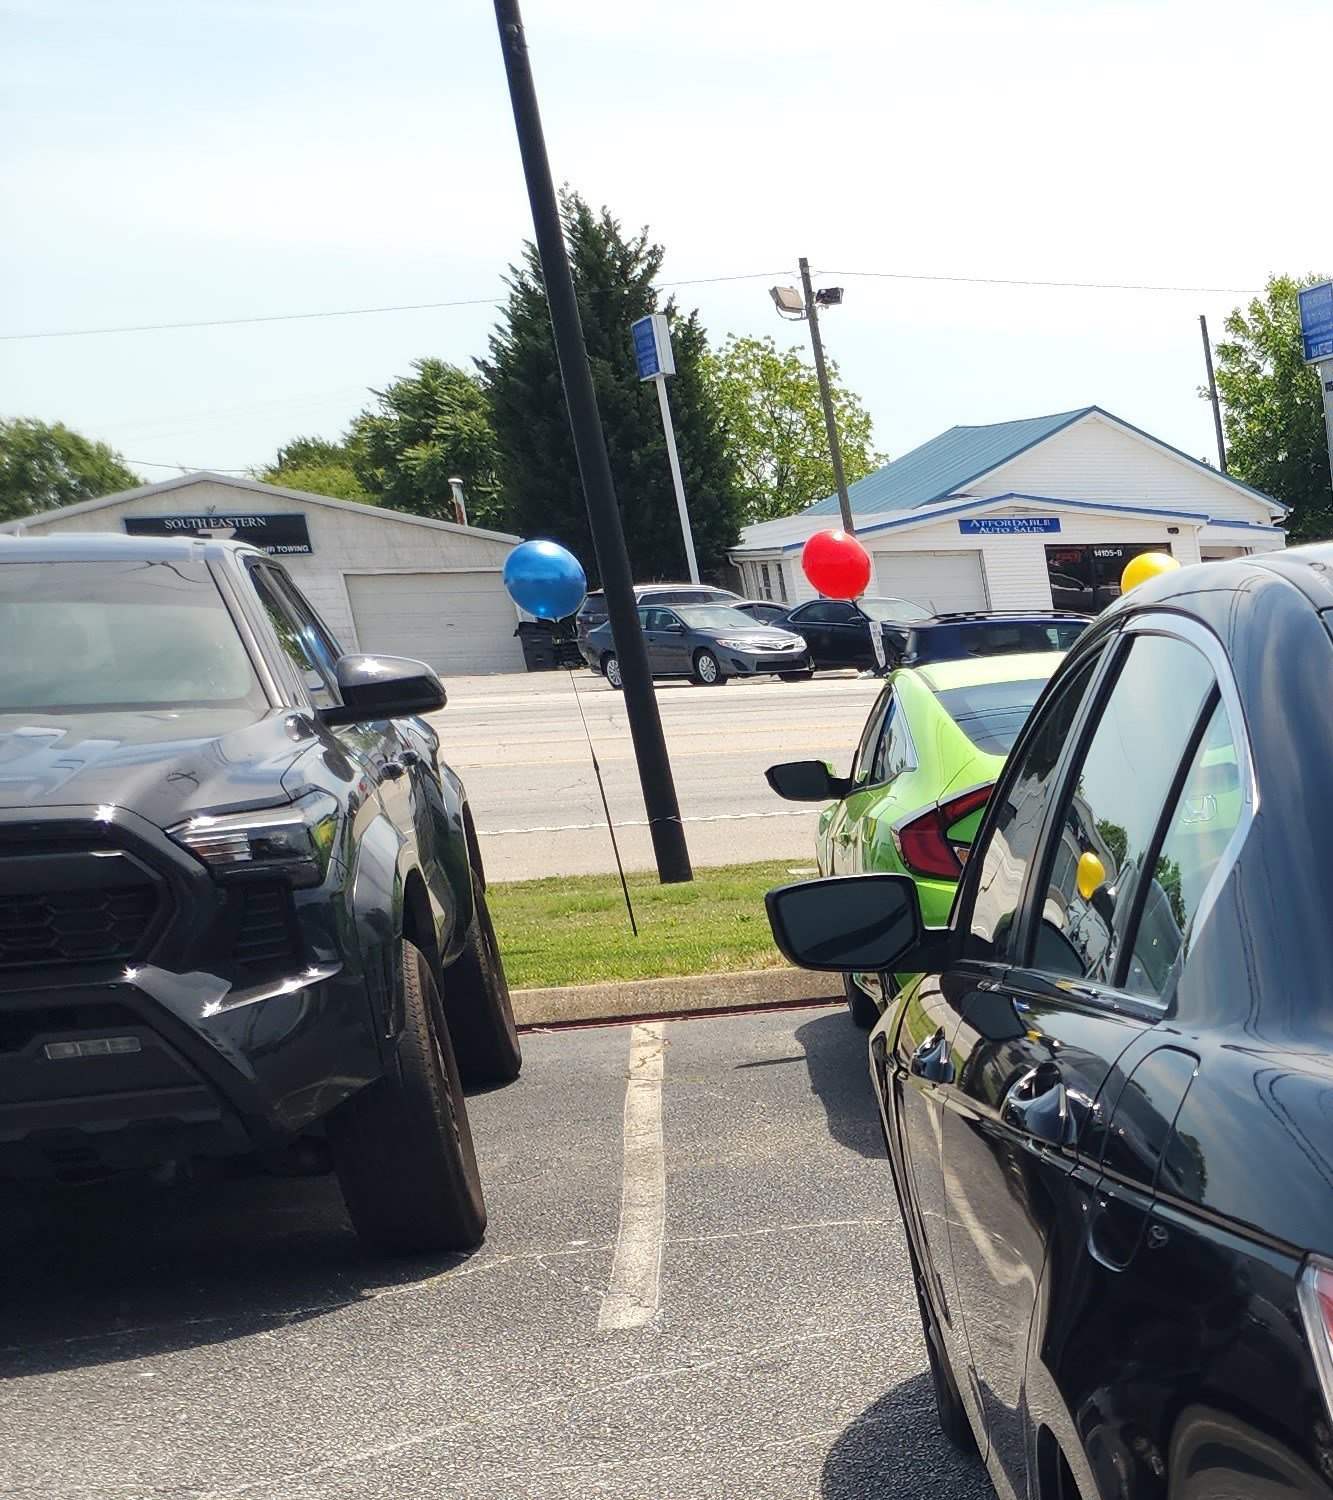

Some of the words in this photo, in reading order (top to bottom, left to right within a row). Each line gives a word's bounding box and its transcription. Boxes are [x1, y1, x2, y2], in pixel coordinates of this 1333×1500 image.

[164, 517, 207, 529] SOUTH
[210, 516, 267, 528] EASTERN
[970, 519, 1051, 528] AFFORDABLE
[276, 544, 309, 553] TOWING
